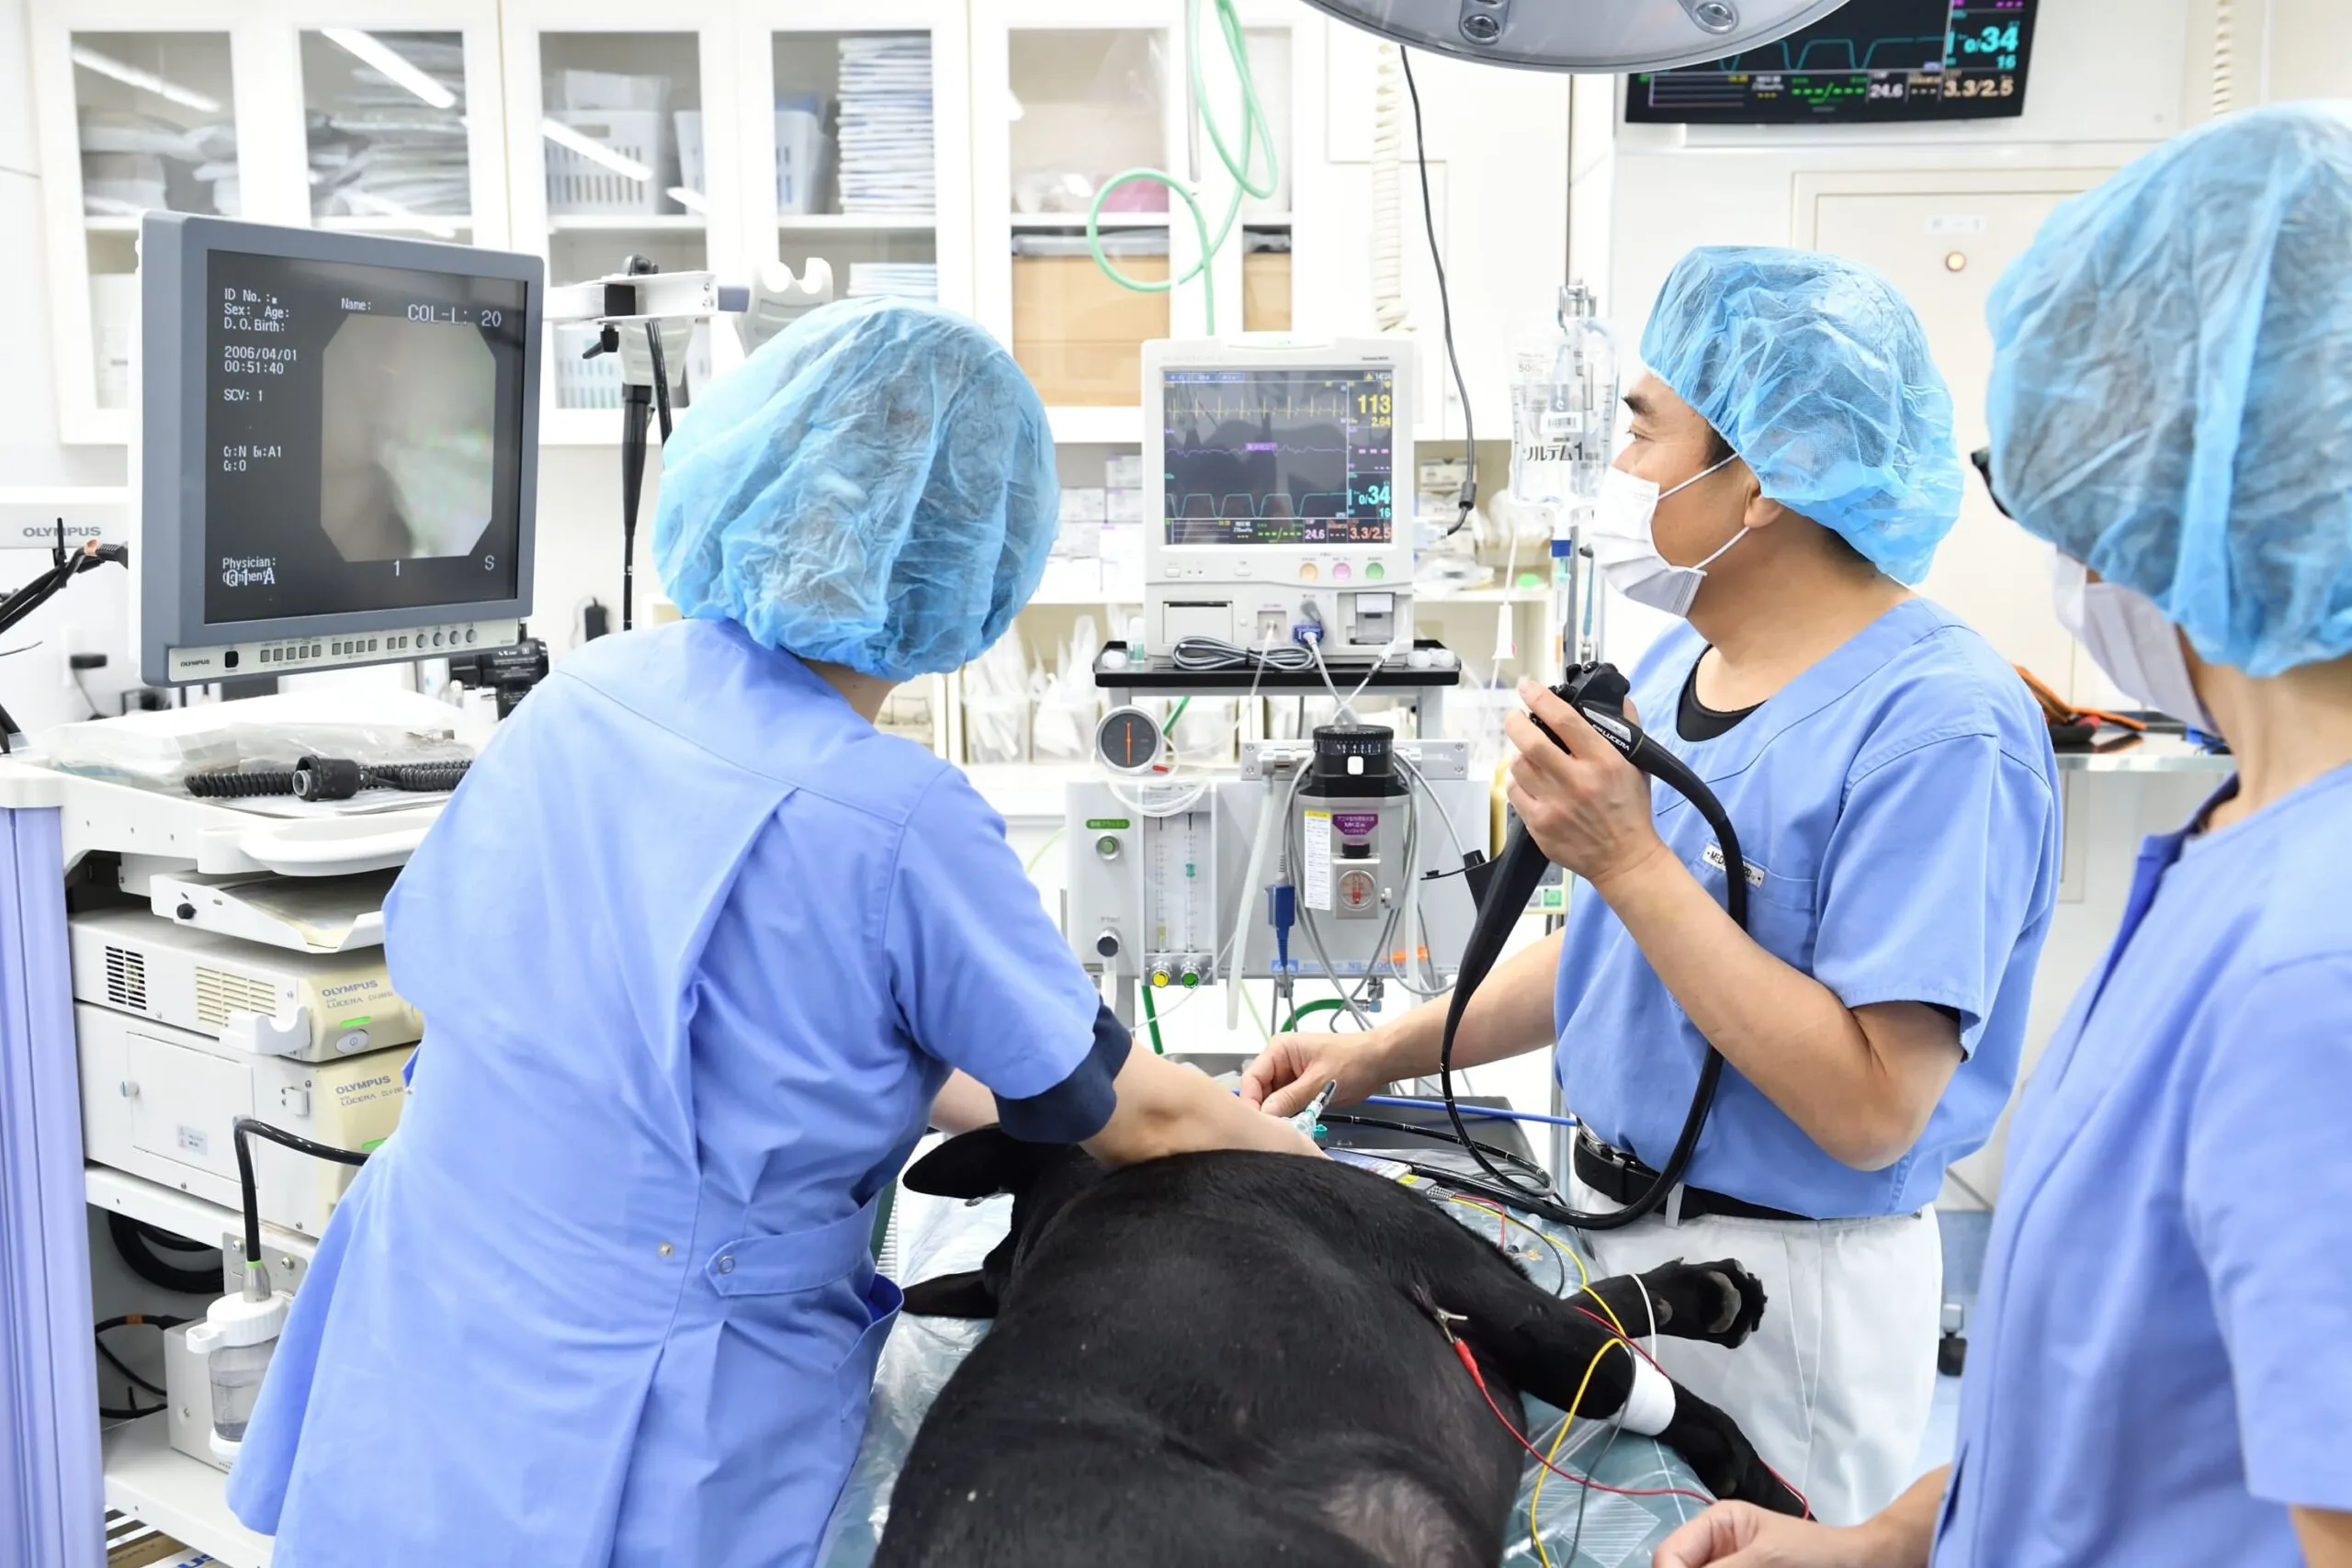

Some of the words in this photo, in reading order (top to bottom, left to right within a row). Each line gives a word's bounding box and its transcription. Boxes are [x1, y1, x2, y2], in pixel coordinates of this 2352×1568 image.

[1944, 78, 2014, 97] 3.3/2.5
[224, 288, 236, 300] ID
[224, 303, 251, 315] Sex:
[265, 306, 289, 320] Age:
[341, 298, 371, 311] Name:
[408, 304, 468, 324] COL-L:
[481, 310, 502, 327] 20
[224, 345, 297, 361] 2006/04/01
[224, 360, 284, 374] 00:51:40
[223, 389, 250, 400] SCV:
[258, 389, 264, 401] 1
[1358, 395, 1392, 414] 113
[1379, 507, 1392, 518] 16
[1305, 529, 1326, 540] 24.6
[1350, 526, 1392, 540] 3.3/2.5
[222, 557, 277, 570] Physician:
[393, 560, 401, 577] 1
[484, 555, 495, 570] S
[180, 658, 209, 668] OLYMPUS
[322, 980, 379, 997] OLYMPUS
[335, 1076, 390, 1094] OLYMPUS
